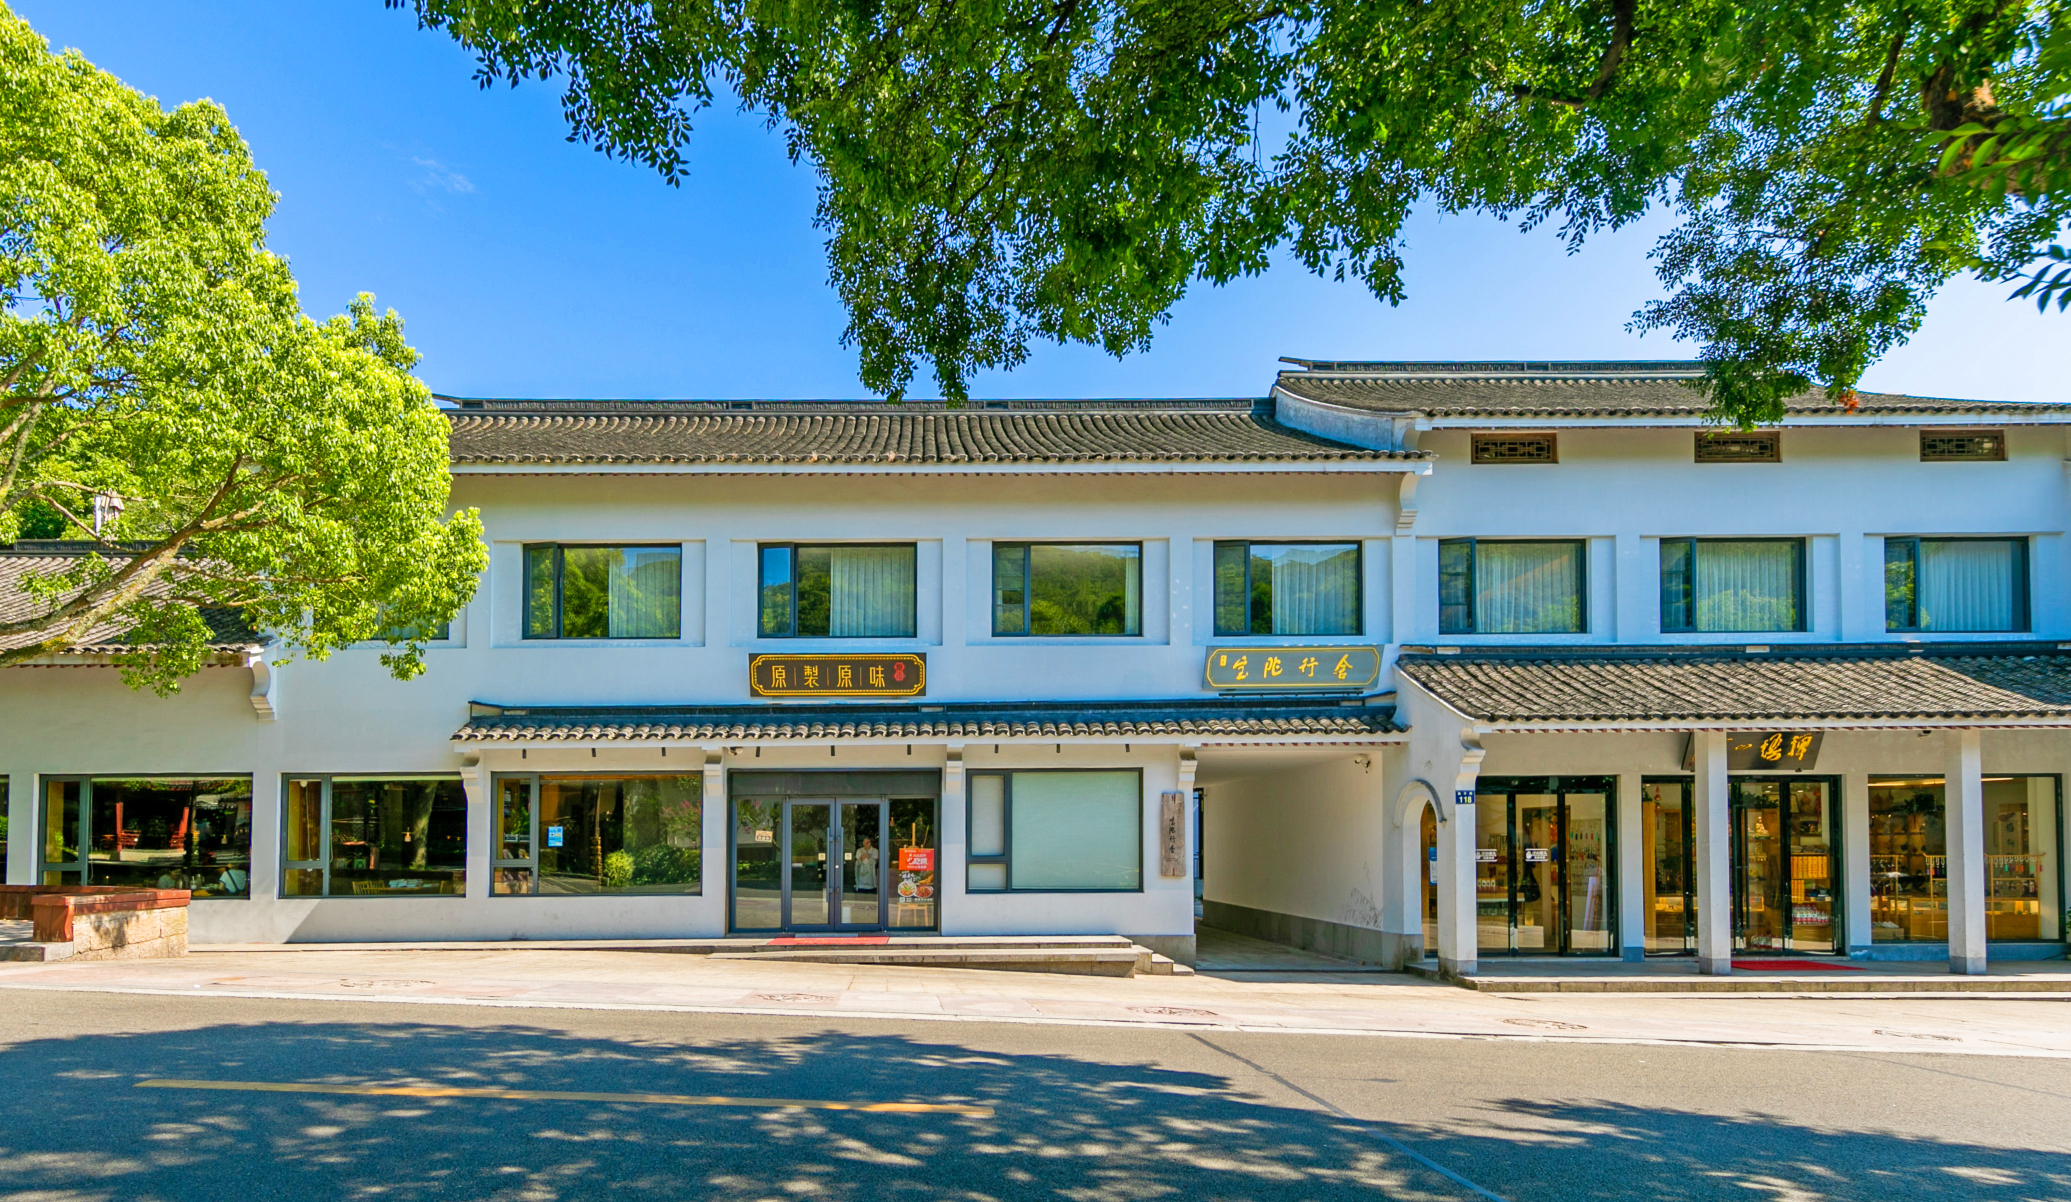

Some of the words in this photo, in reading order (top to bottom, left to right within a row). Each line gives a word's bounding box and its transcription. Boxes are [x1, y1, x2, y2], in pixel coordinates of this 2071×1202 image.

[771, 665, 886, 688] 原製原味
[1459, 796, 1472, 804] 118
